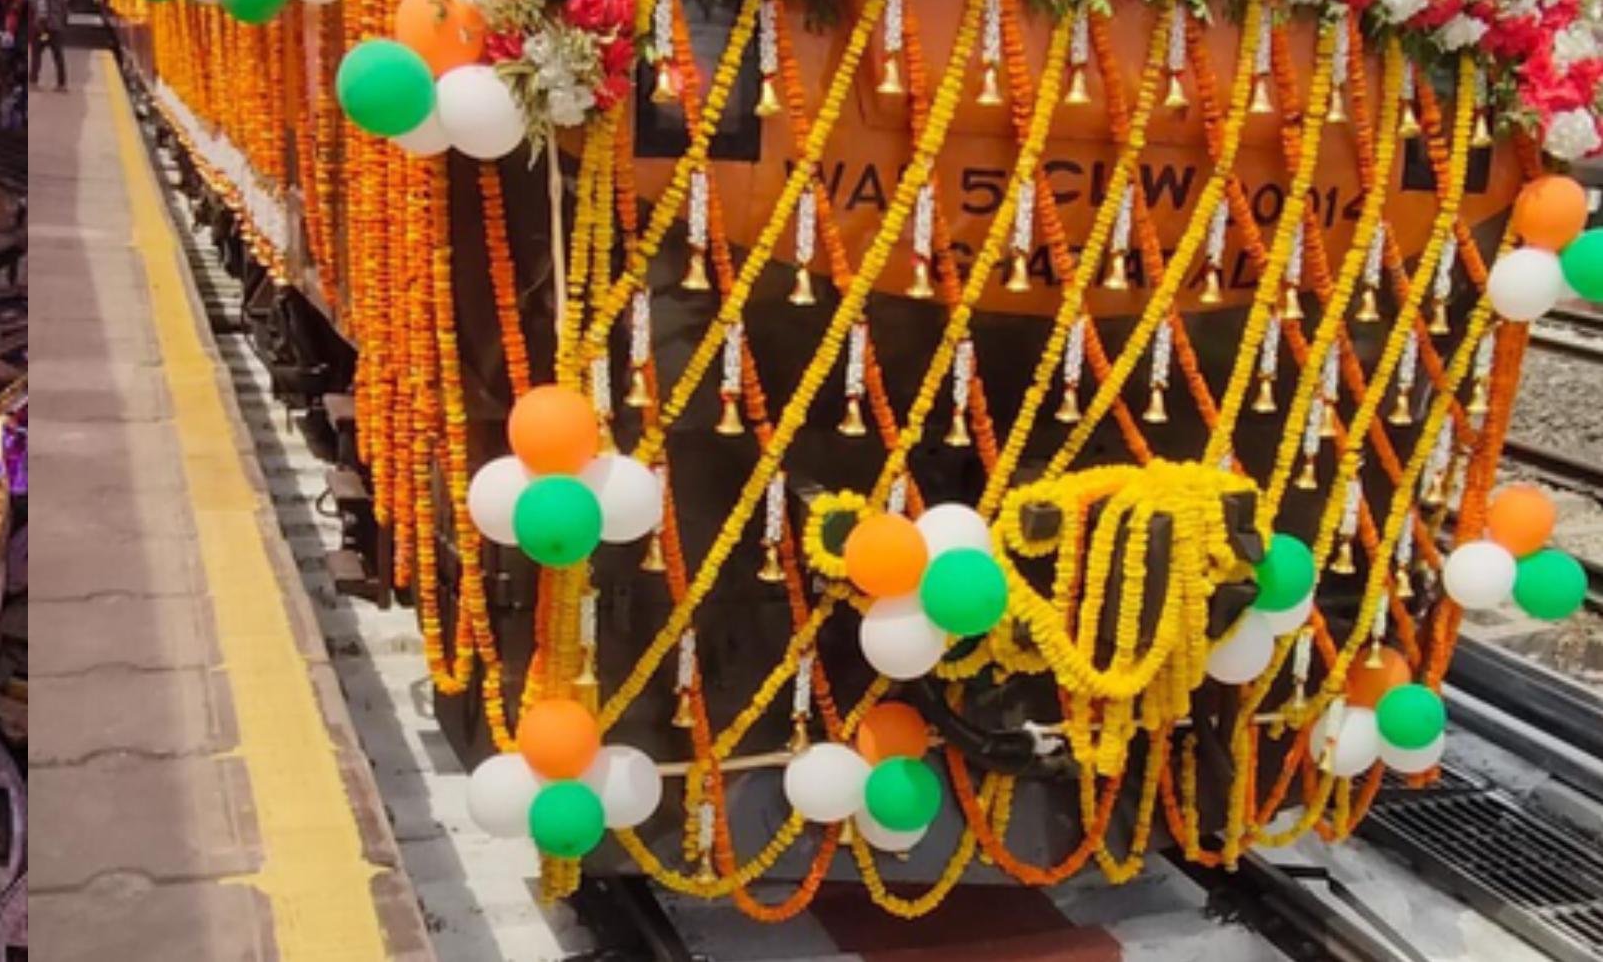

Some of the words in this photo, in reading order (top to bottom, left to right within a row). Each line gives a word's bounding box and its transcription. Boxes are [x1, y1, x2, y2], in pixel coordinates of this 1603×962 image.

[784, 158, 924, 213] WA
[961, 167, 1007, 214] 5
[1227, 182, 1371, 229] 014
[930, 241, 1266, 288] GAIAAD
